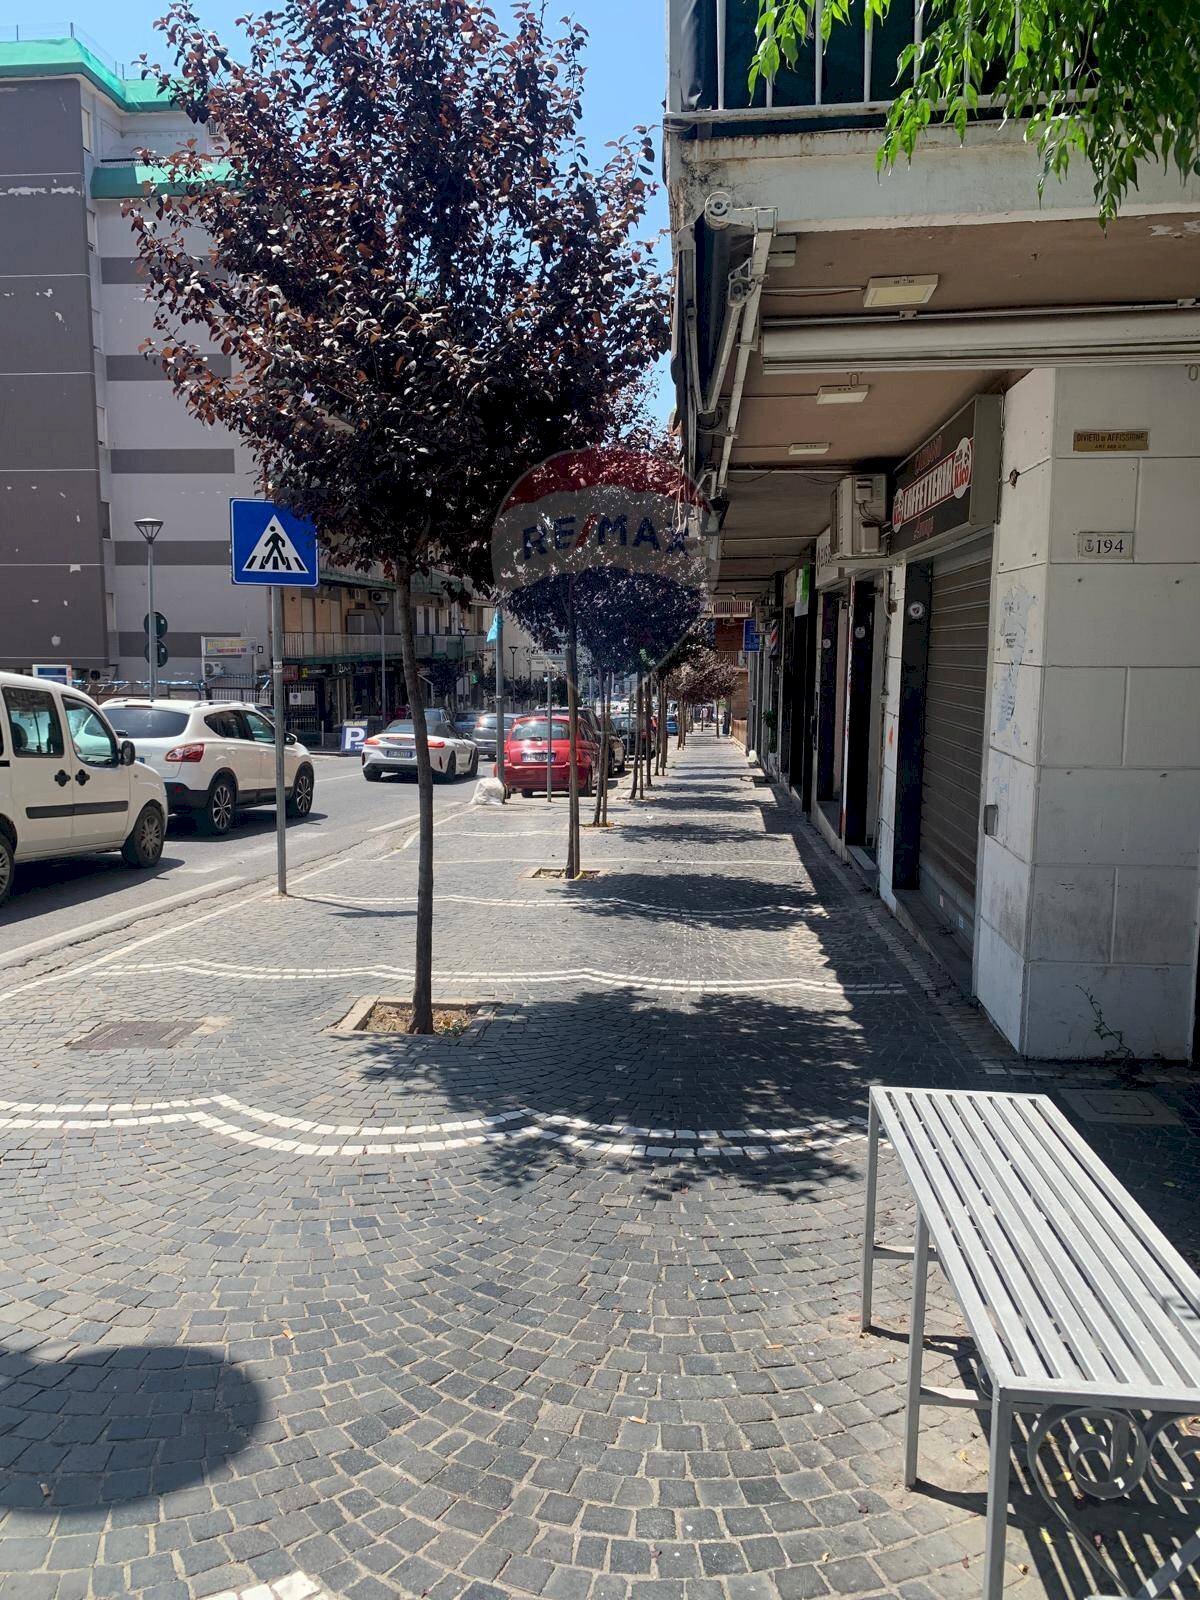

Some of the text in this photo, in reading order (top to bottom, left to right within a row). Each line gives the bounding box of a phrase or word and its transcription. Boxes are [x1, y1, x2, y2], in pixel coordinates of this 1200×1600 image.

[1076, 433, 1100, 442] DIVIETO
[1107, 432, 1145, 442] AFFISSIONE
[903, 457, 953, 521] CAFFETTERIA
[1095, 539, 1124, 554] 194
[344, 727, 365, 749] P
